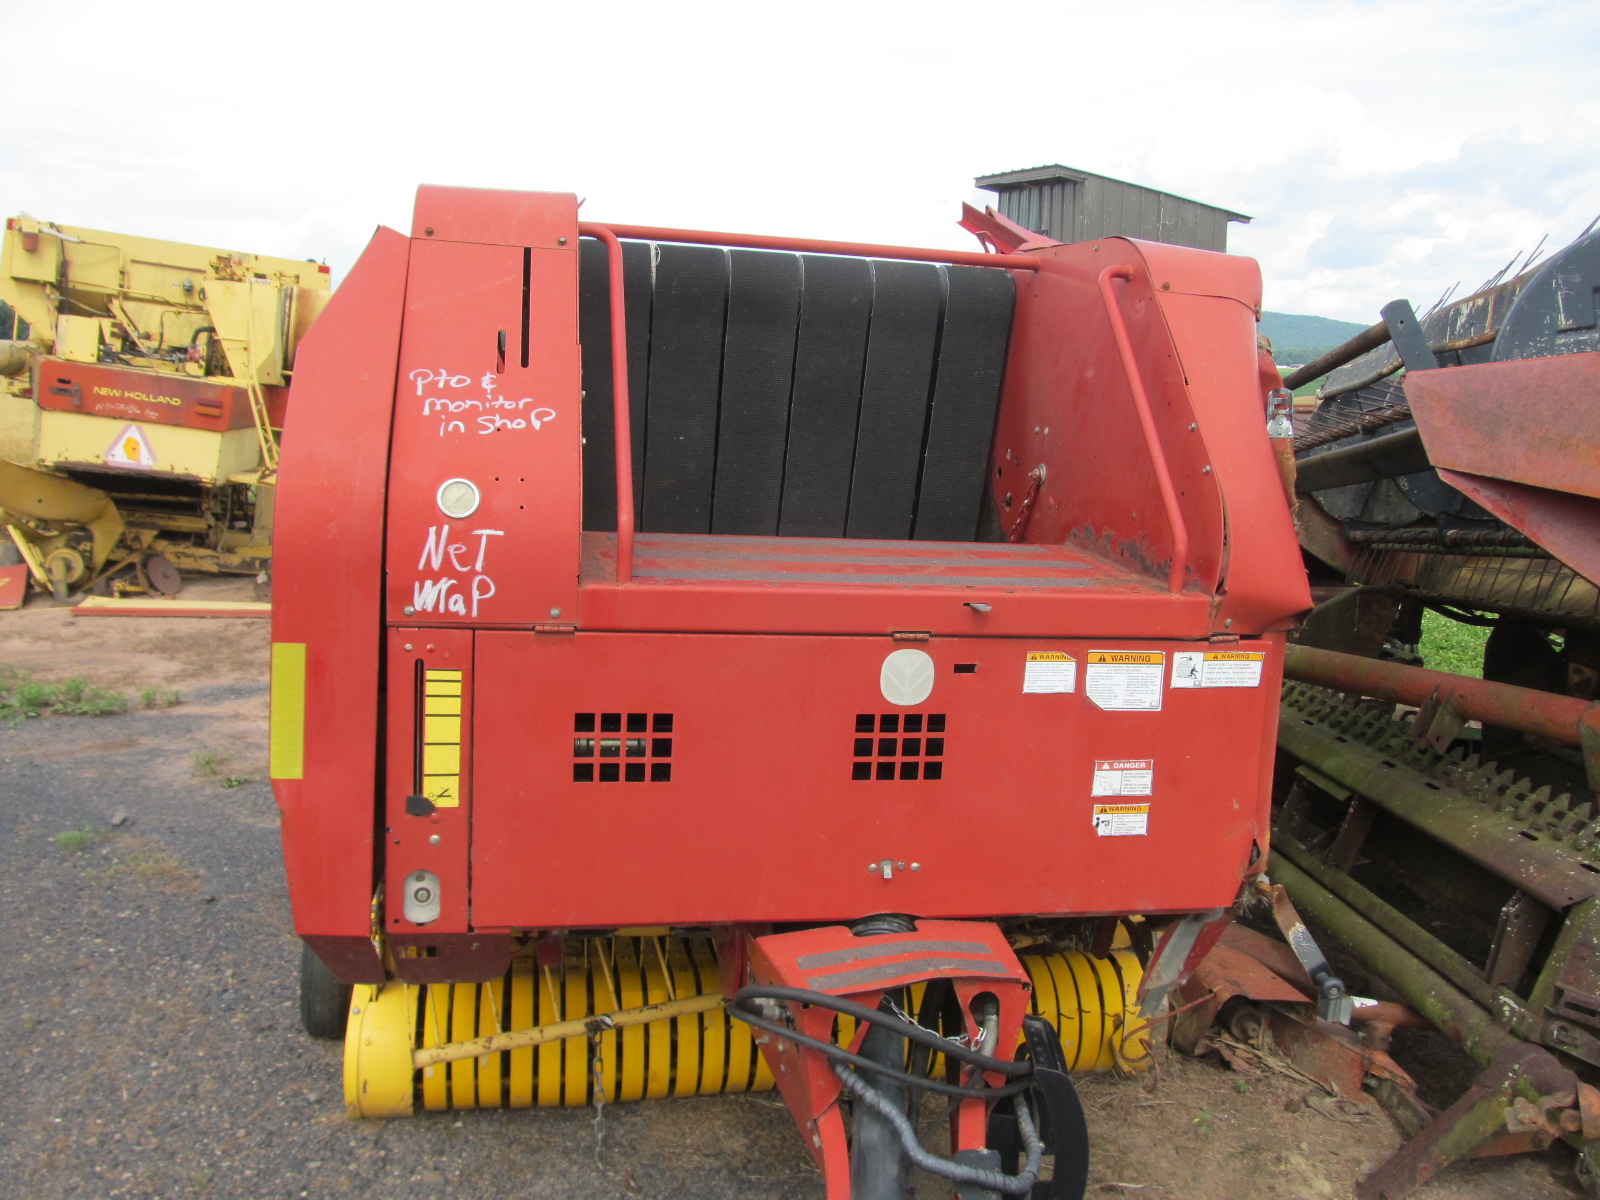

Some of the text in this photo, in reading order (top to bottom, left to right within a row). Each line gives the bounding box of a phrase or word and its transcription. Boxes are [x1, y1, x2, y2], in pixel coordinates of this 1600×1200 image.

[93, 386, 182, 406] NEW HOLLAND
[422, 394, 533, 416] monitor
[439, 415, 466, 437] in
